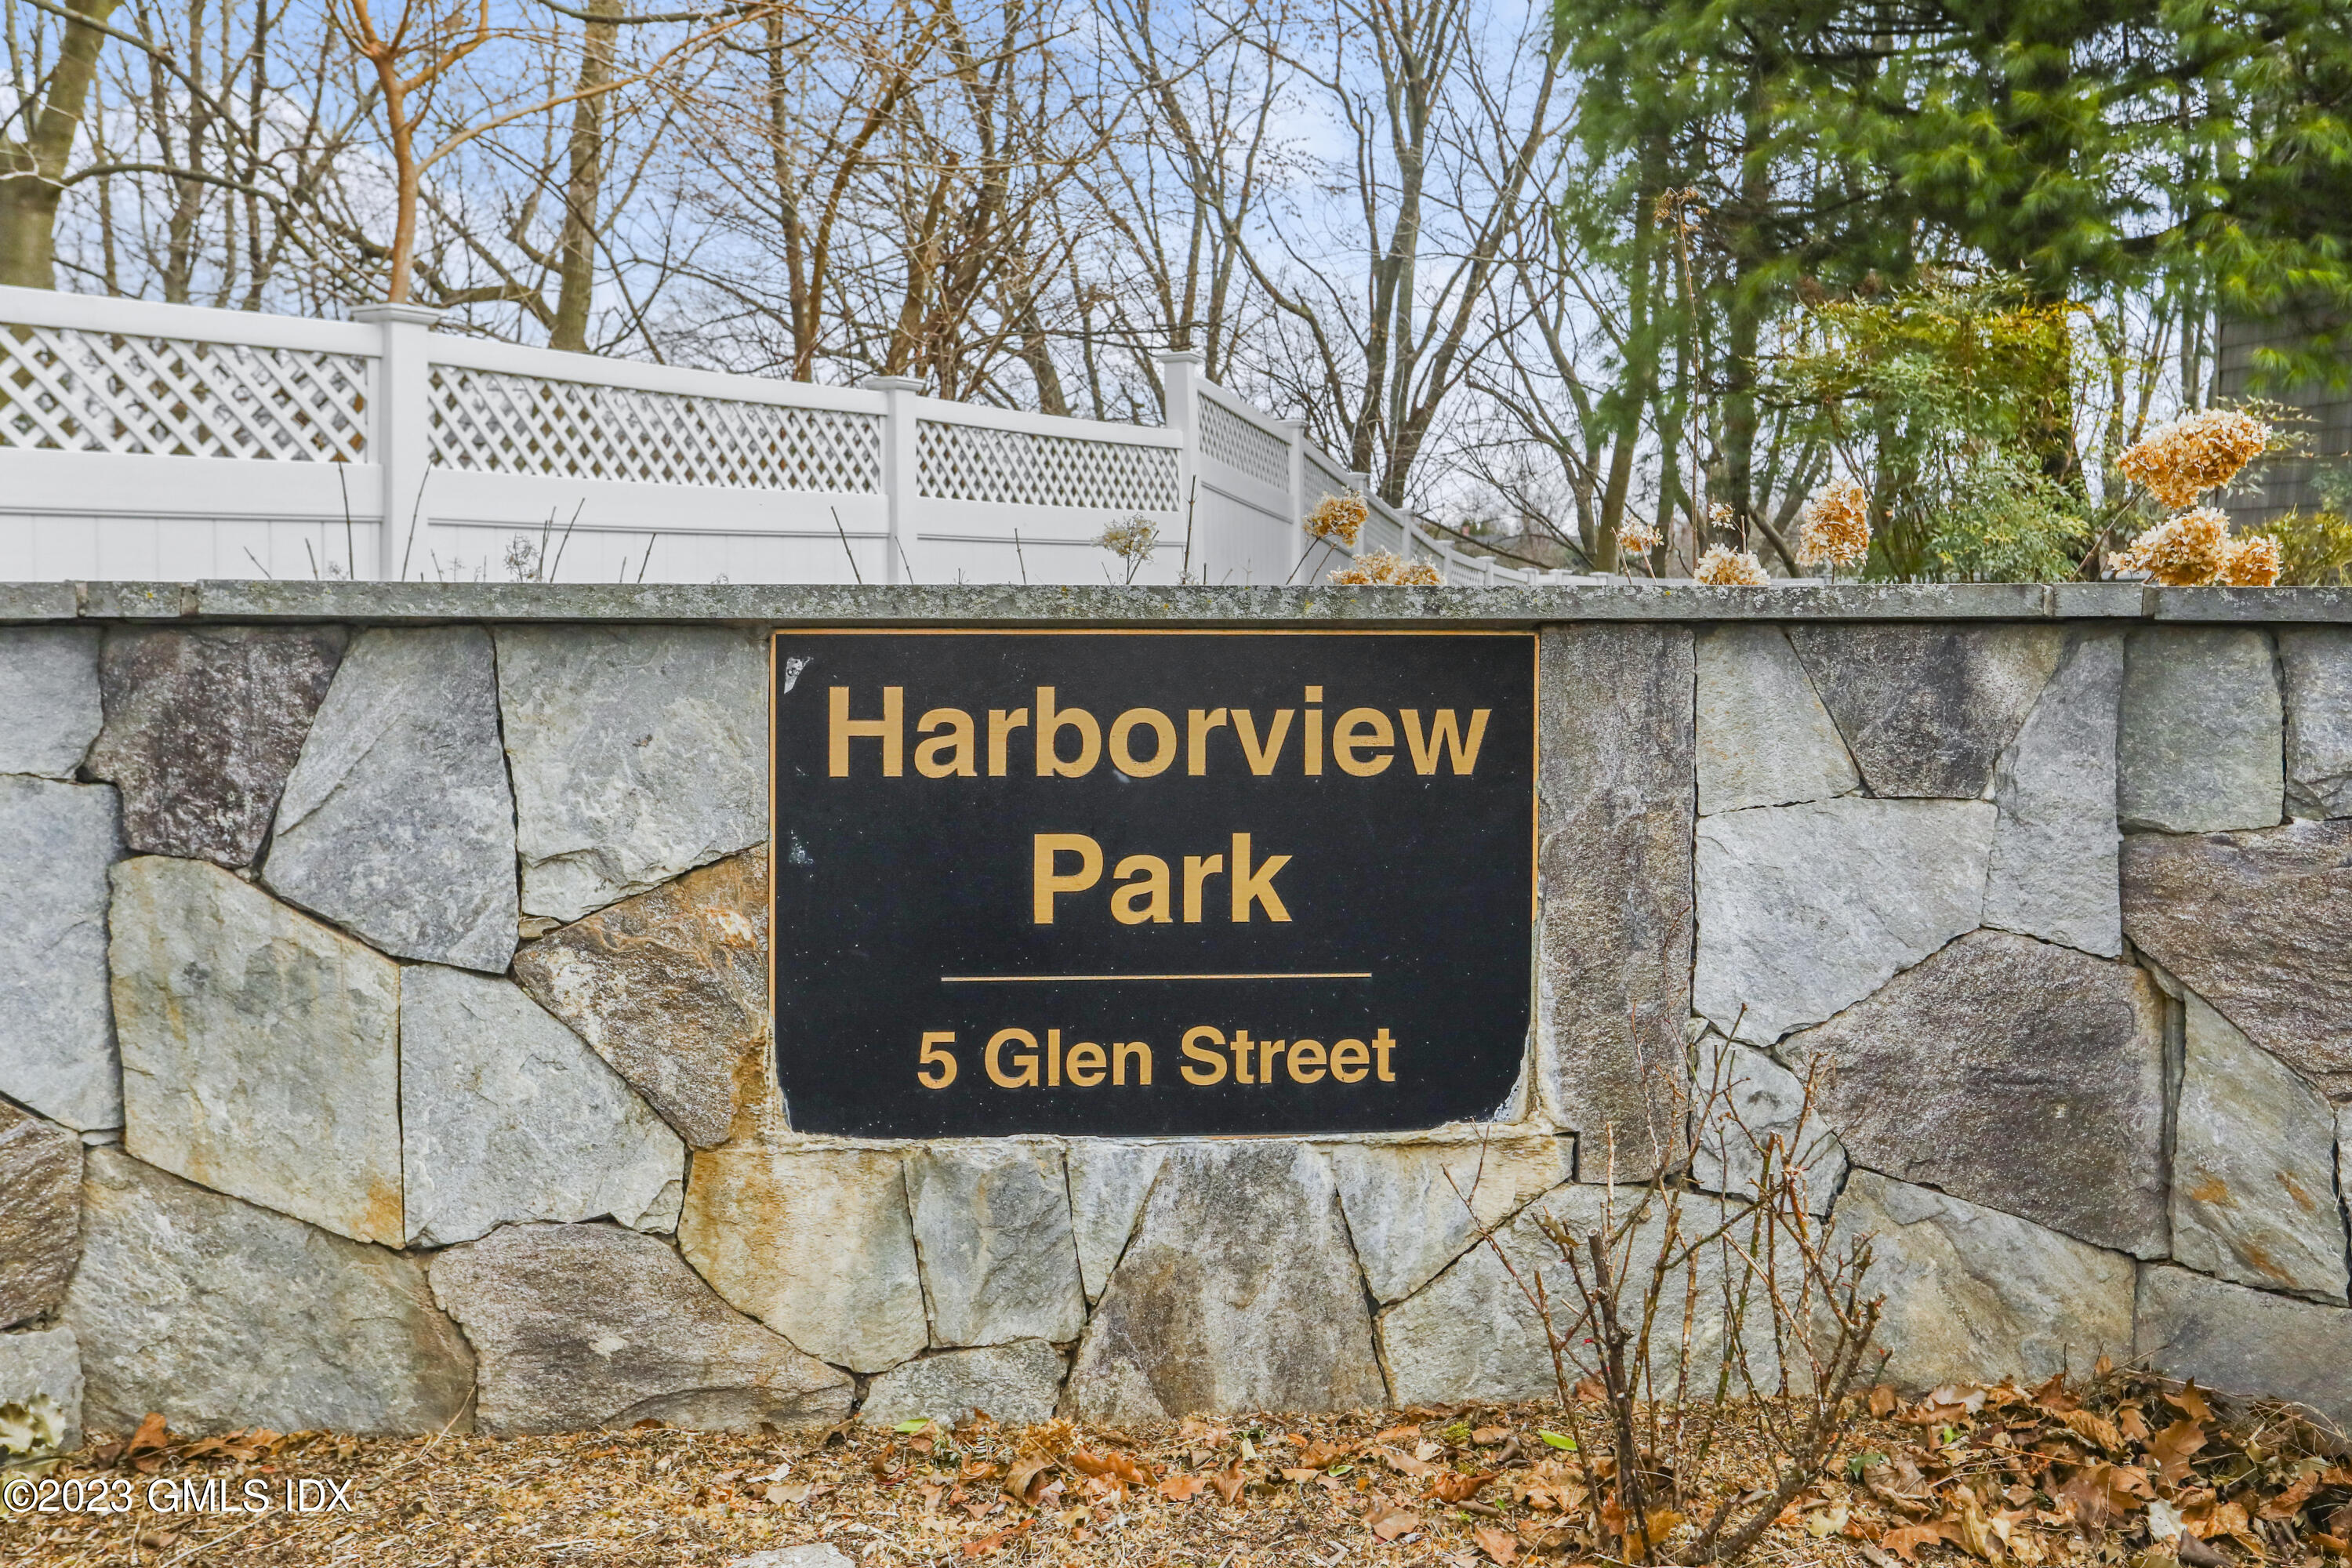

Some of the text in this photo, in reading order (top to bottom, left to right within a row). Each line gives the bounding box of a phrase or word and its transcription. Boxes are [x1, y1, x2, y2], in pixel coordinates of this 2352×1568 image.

[829, 685, 1493, 779] Harborview
[1033, 832, 1293, 925] Park
[917, 1025, 1396, 1090] 5 Glen Street
